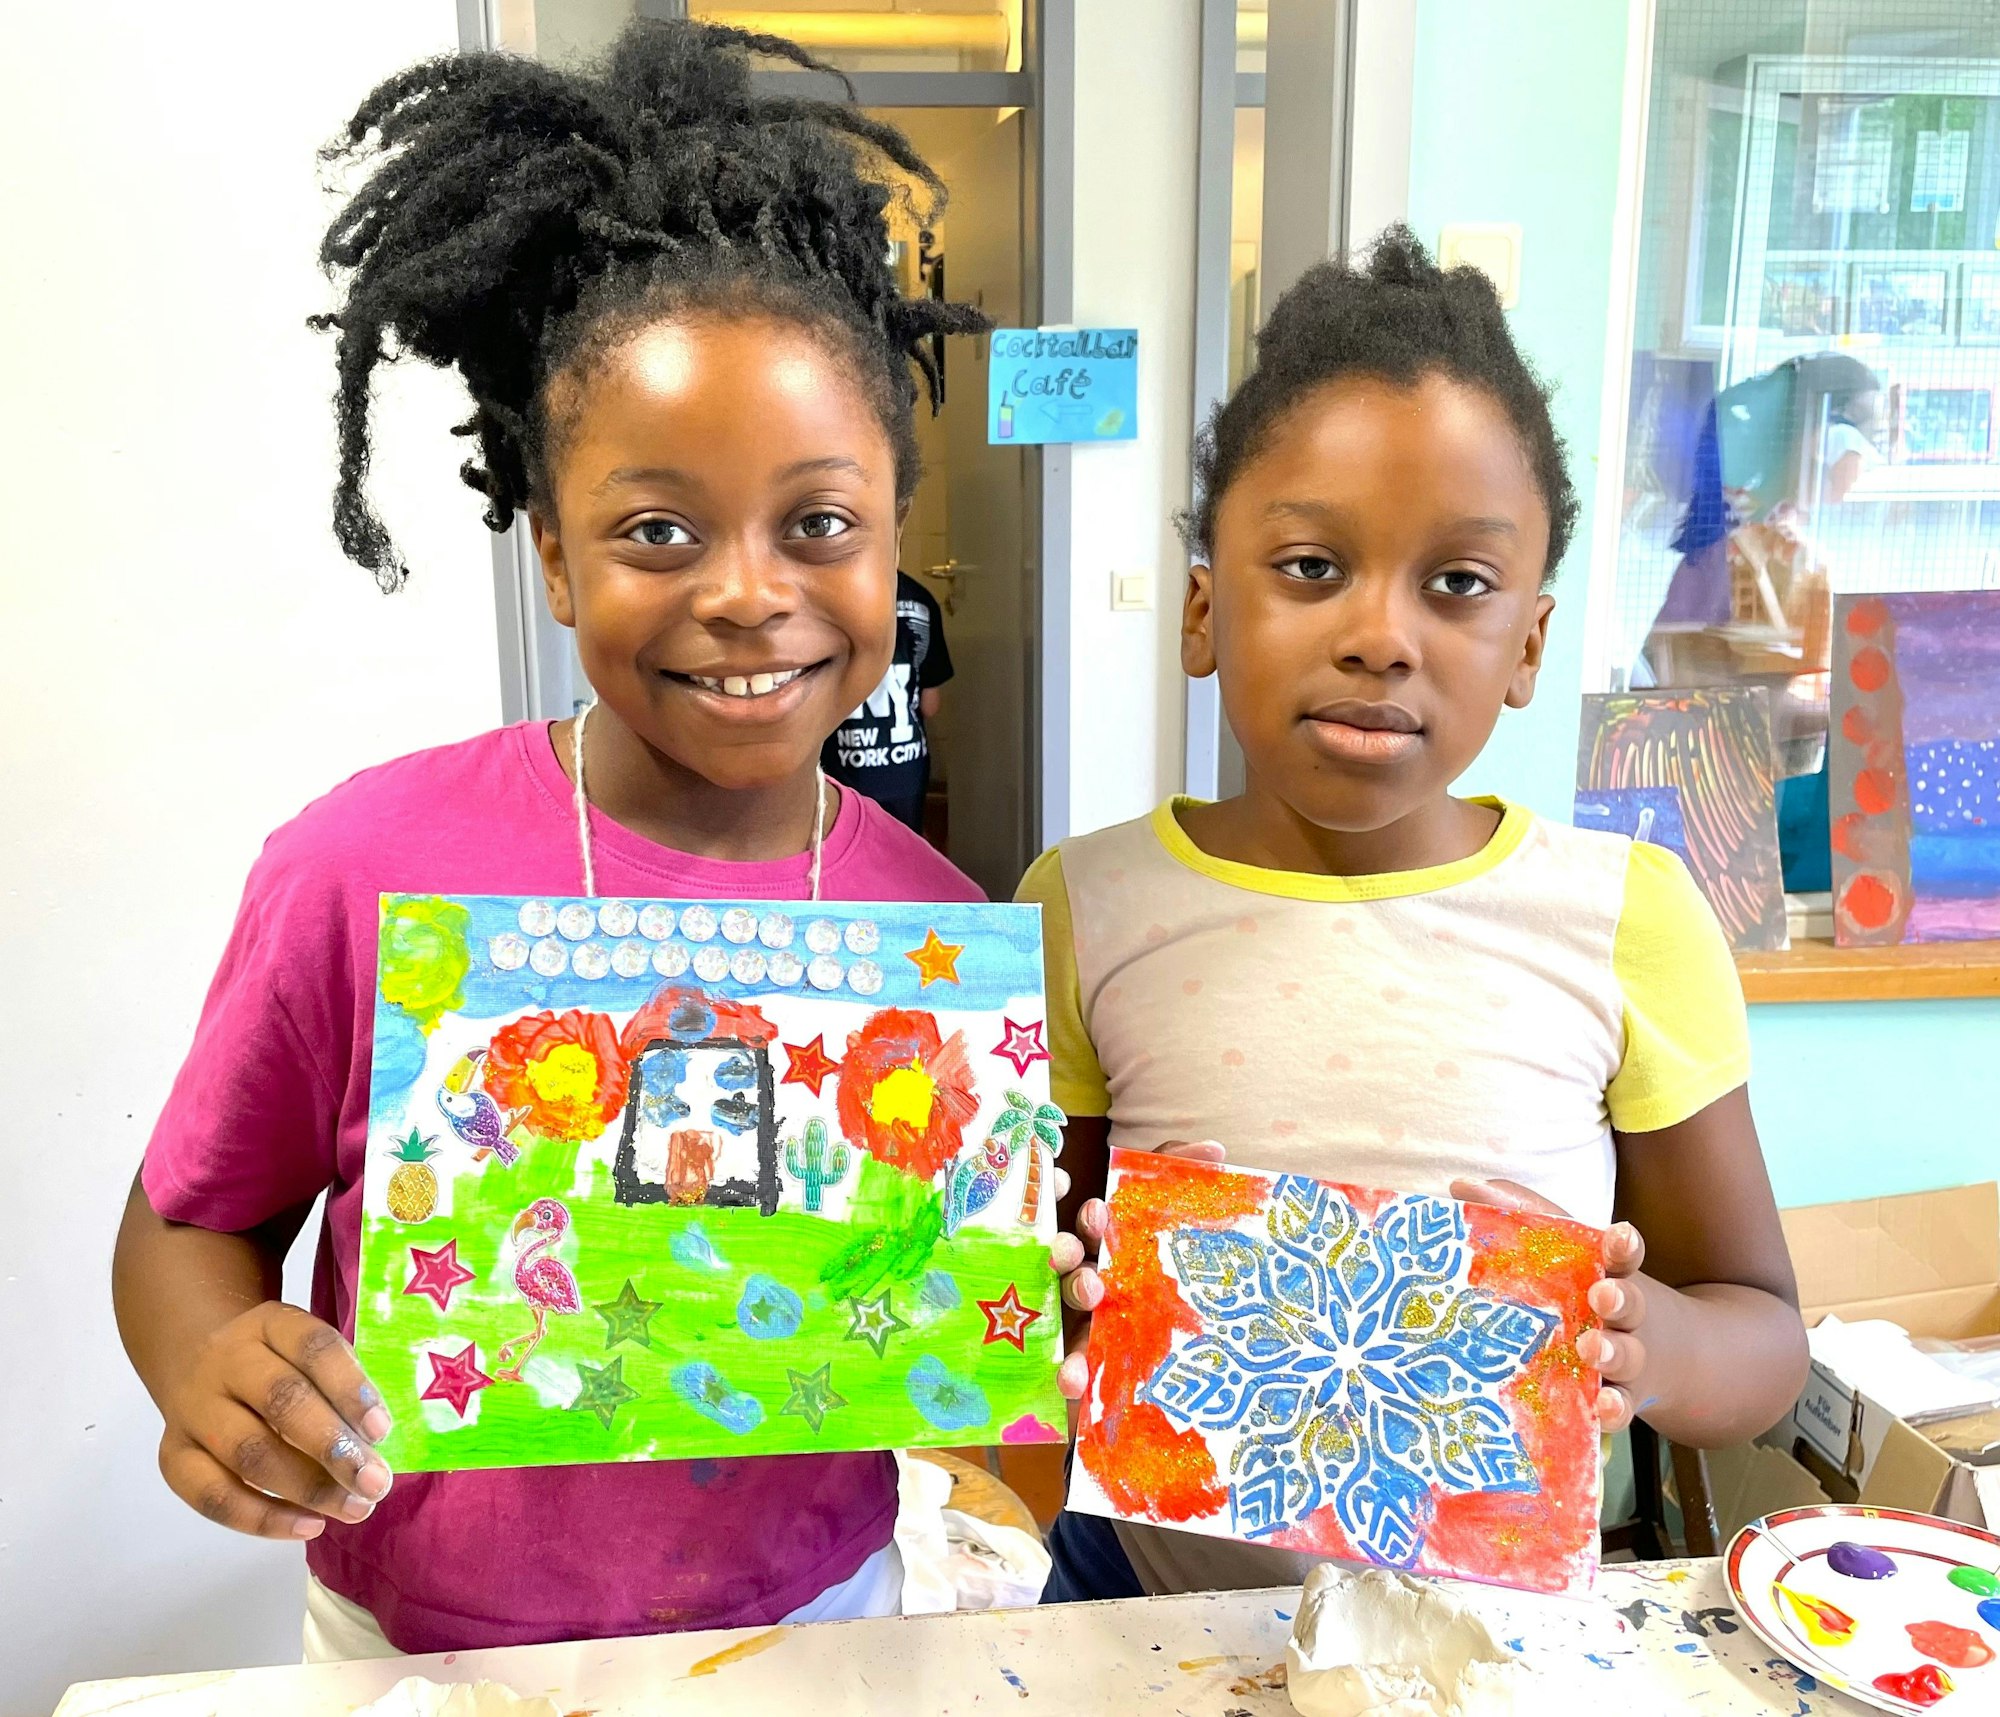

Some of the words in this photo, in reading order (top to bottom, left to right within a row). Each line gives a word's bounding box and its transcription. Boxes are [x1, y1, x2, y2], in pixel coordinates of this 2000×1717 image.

[1012, 369, 1092, 399] Café
[837, 727, 879, 747] NEW
[838, 747, 889, 768] YORK
[891, 742, 921, 764] CITY
